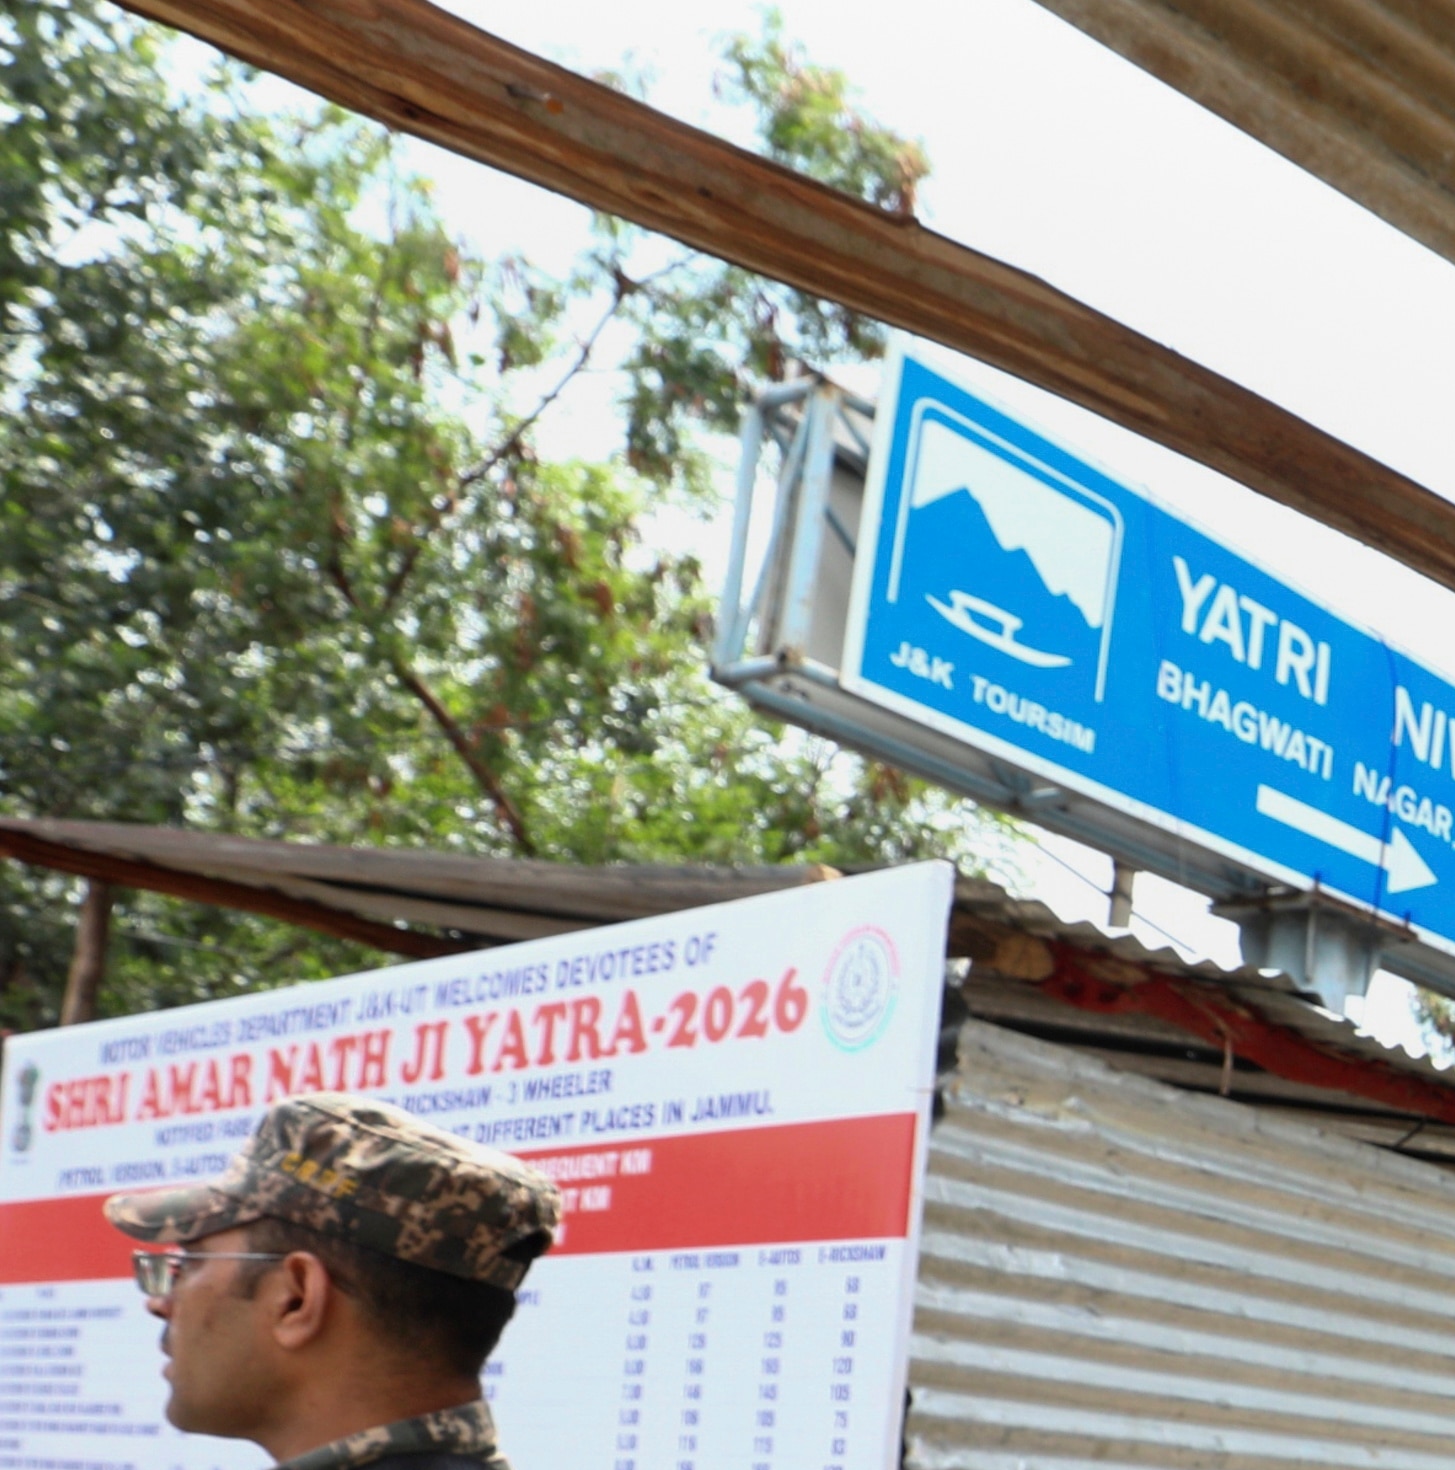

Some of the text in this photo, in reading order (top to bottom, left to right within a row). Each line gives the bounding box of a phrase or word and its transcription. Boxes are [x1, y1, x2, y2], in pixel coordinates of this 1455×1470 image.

[1172, 554, 1332, 706] YATRI
[889, 640, 1096, 755] J&K TOURSIM
[1156, 658, 1335, 781] BHAGWATI
[236, 998, 350, 1042] DEPARTMENT
[434, 962, 549, 1008] WELCOMES
[554, 938, 677, 990] DEVOTEES
[682, 931, 718, 968] OF
[44, 967, 808, 1133] SHRI AMAR NATH JI YATRA-2026
[524, 1068, 614, 1100] WHEELER
[474, 1112, 577, 1146] DIFFERENT
[579, 1102, 655, 1134] PLACES
[660, 1099, 683, 1125] IN
[829, 1383, 850, 1402] 105
